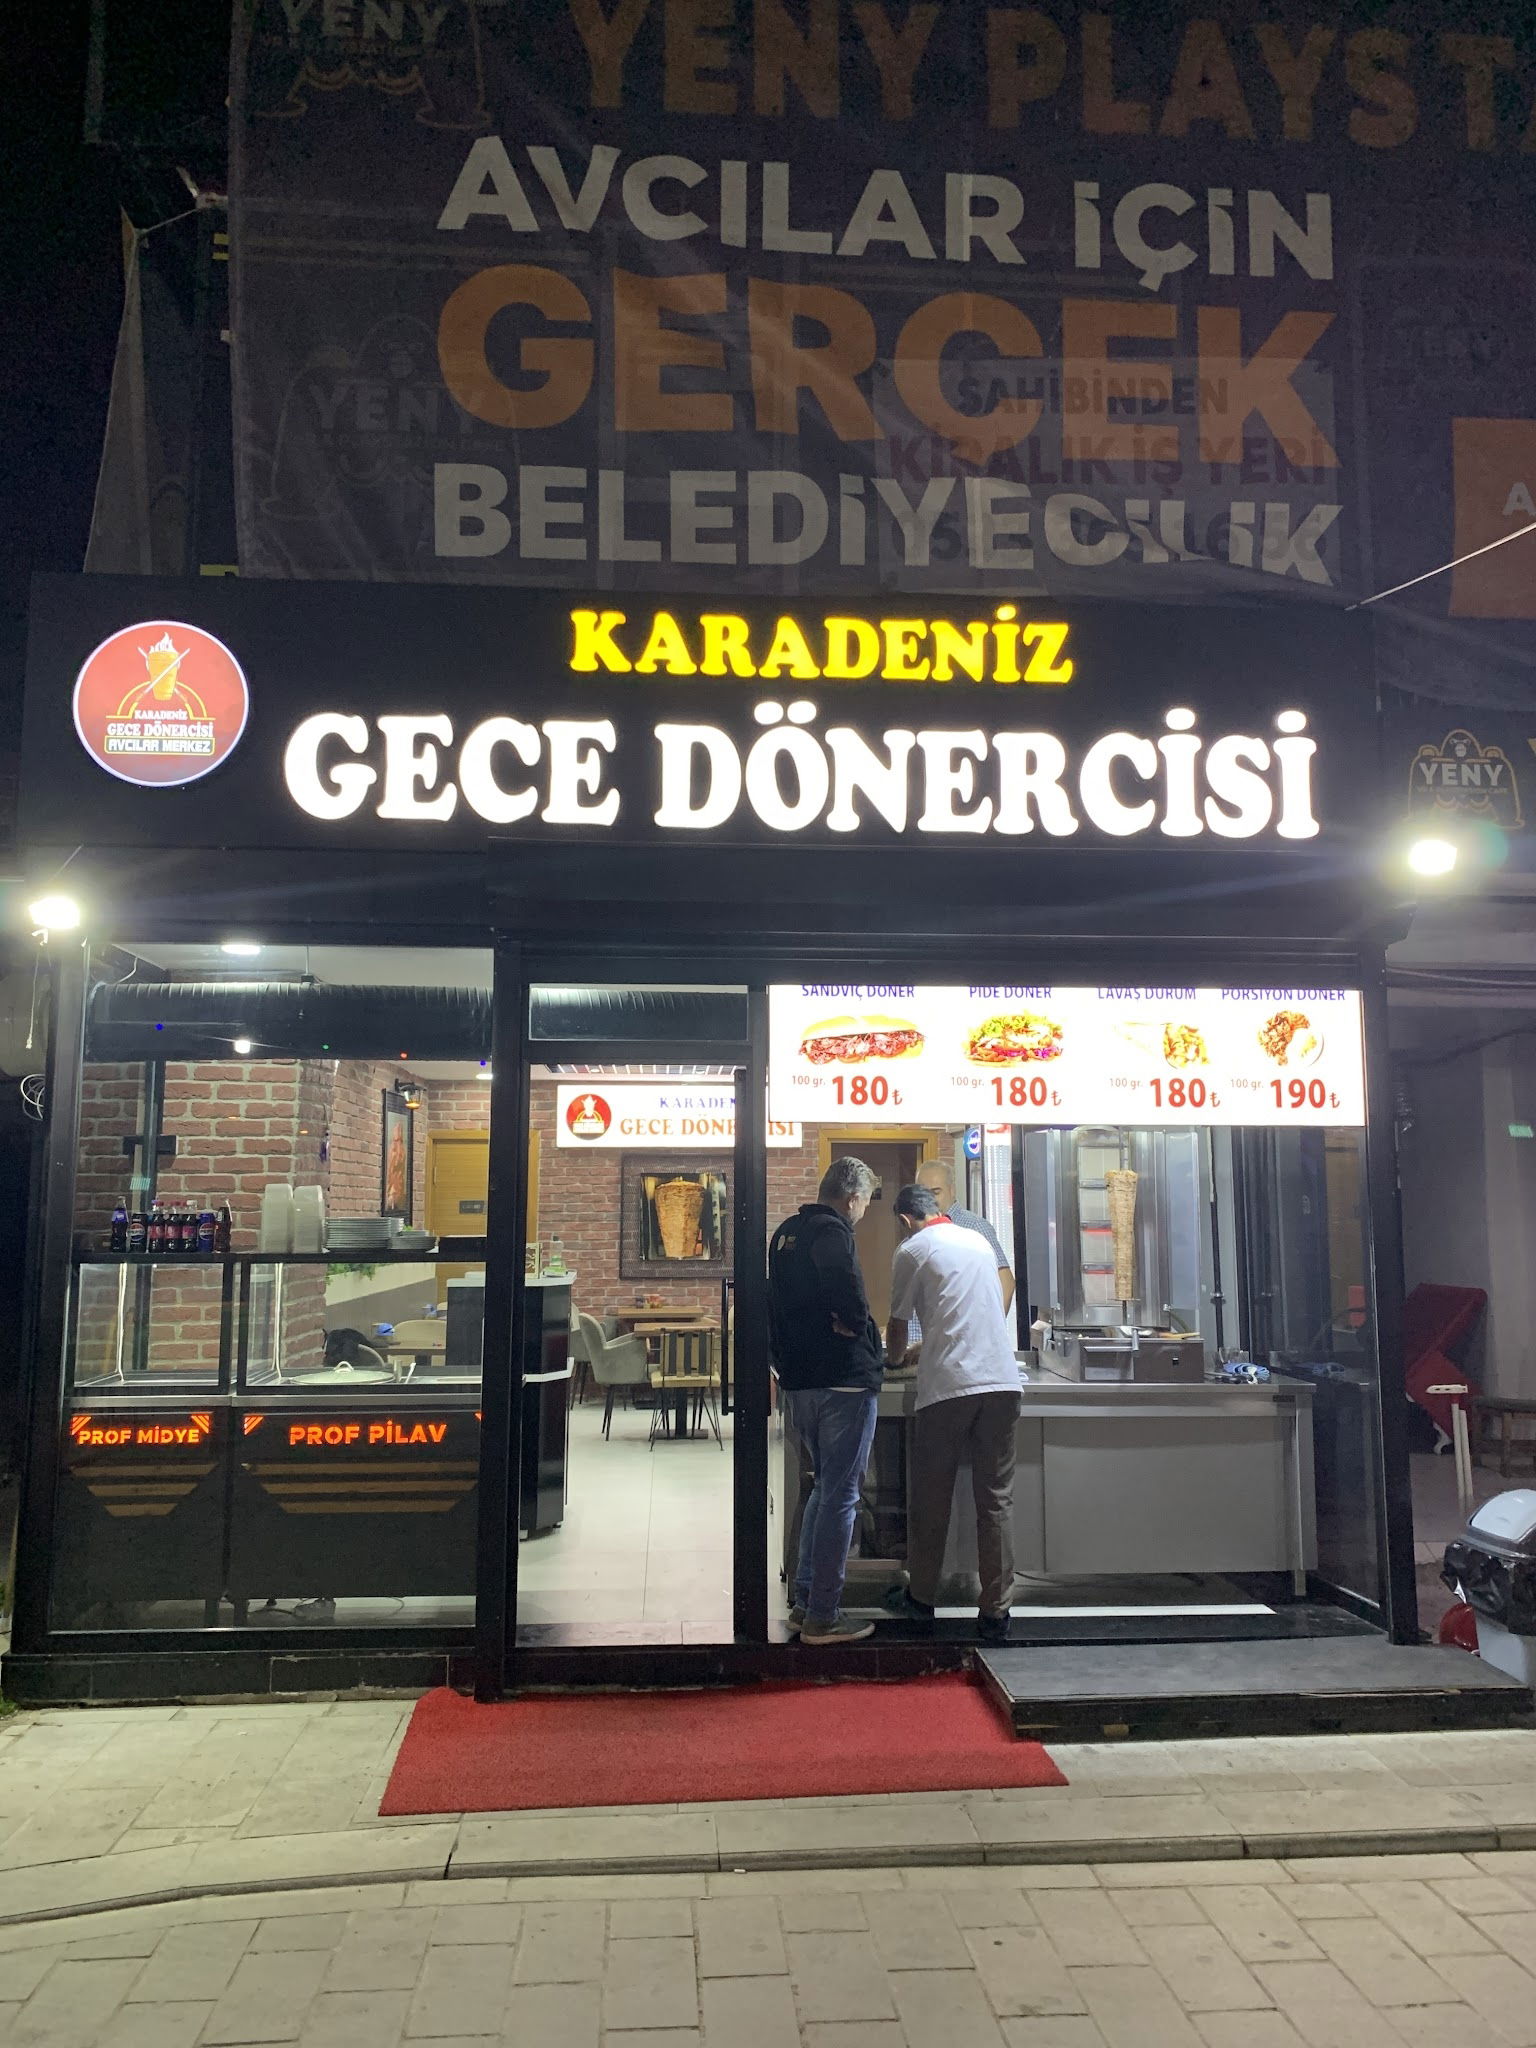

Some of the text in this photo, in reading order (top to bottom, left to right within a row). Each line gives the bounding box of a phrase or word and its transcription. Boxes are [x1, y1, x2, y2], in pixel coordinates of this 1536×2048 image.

[568, 0, 1536, 153] YENY PLAYST
[435, 134, 1334, 291] AVCILAR İÇİN
[435, 263, 1341, 470] GERÇEK
[570, 605, 1073, 684] KARADENİZ
[134, 709, 188, 720] KARADENİZ
[107, 720, 214, 738] GECE DÖNERCİSİ
[108, 739, 211, 753] AVCILAR MERKEZ
[283, 700, 1321, 840] GECE DÖNERCİSİ
[1420, 762, 1503, 786] YENY
[791, 1075, 810, 1085] 100
[951, 1076, 968, 1086] 100
[1109, 1078, 1127, 1087] 100
[1231, 1078, 1248, 1088] 100
[620, 1118, 674, 1136] GECE
[79, 1425, 200, 1445] PROF MİDYE
[289, 1420, 447, 1446] PROF PİLAV
